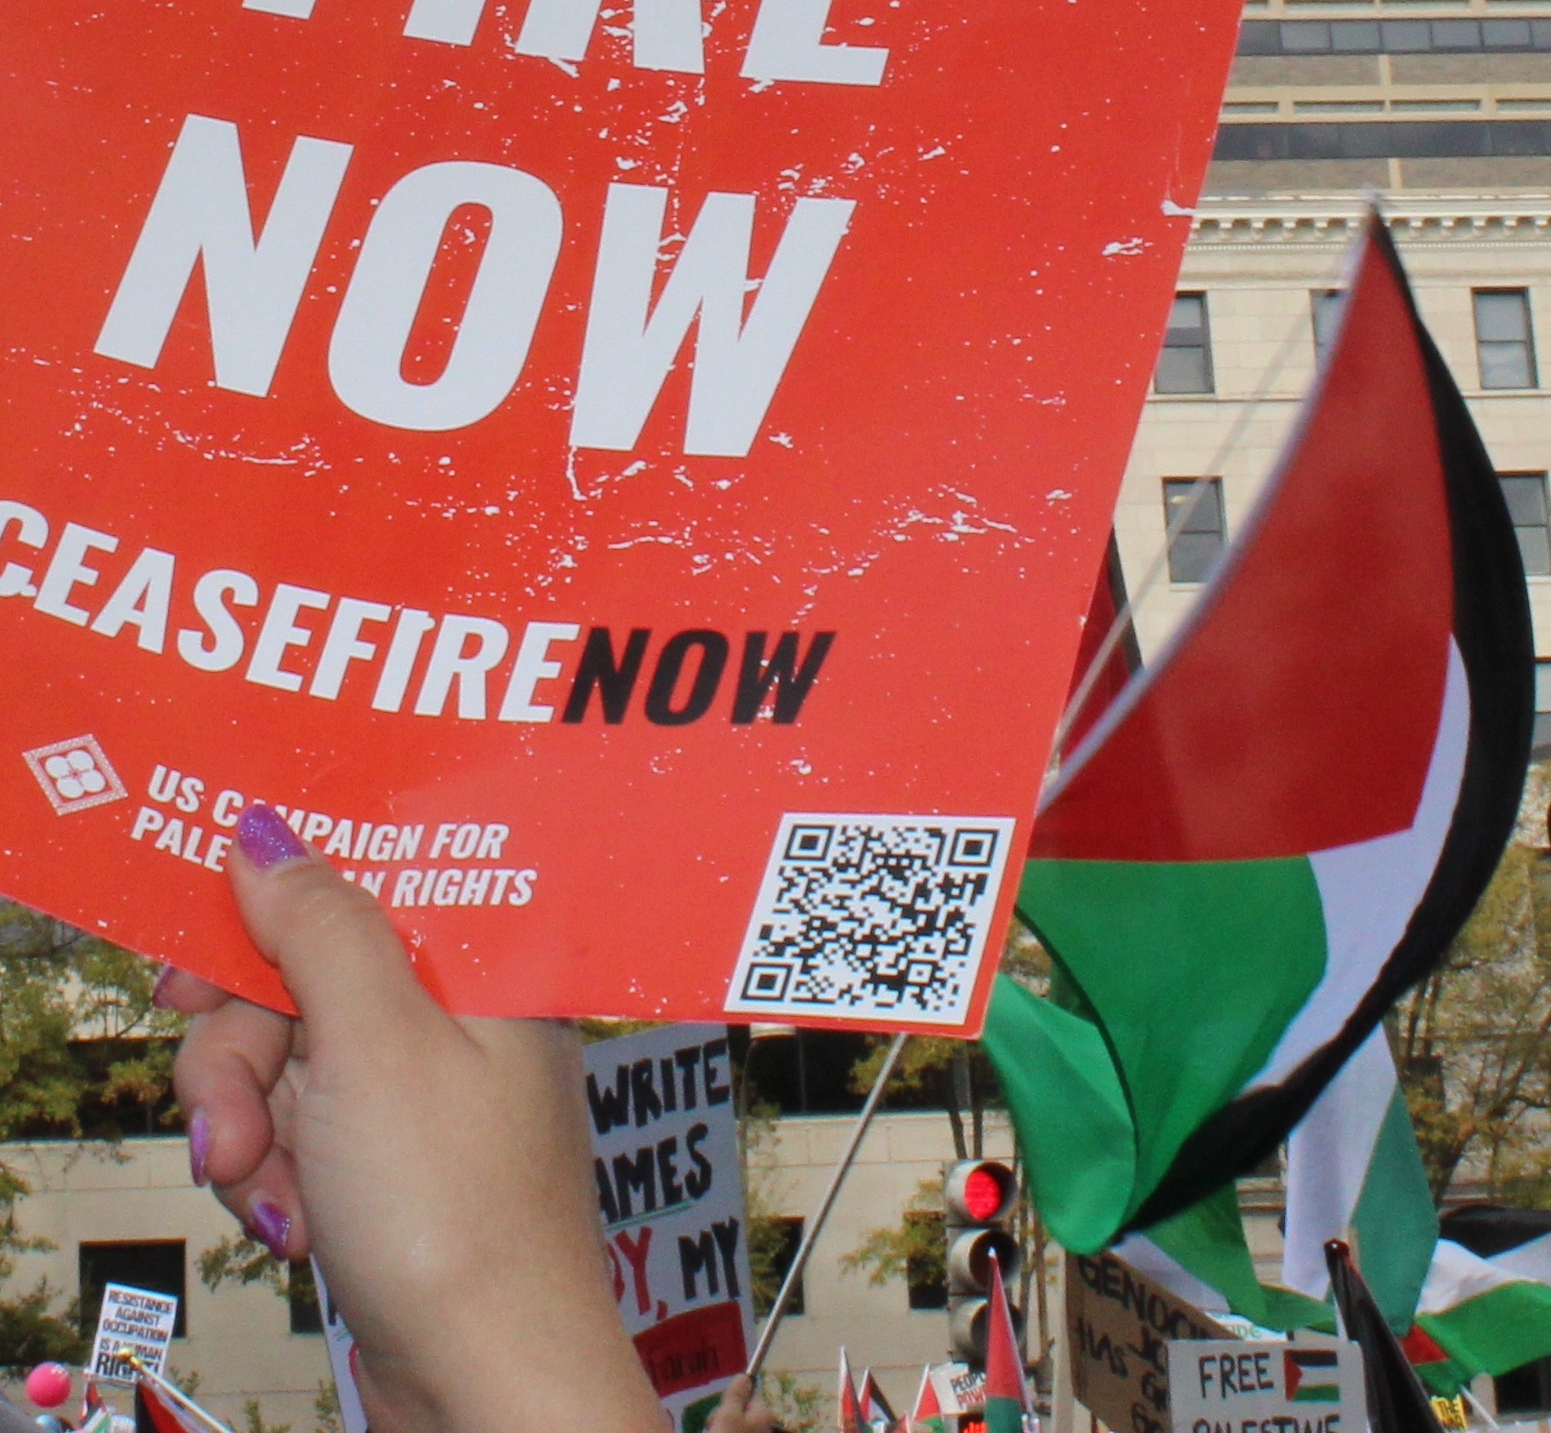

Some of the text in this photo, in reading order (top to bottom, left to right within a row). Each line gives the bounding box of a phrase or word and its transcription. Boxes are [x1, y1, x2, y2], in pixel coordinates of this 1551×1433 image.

[93, 113, 856, 457] NOW
[146, 764, 206, 814] US
[211, 788, 425, 862] CMPAIGN
[429, 822, 510, 860] FOR
[390, 868, 539, 908] RIGHTS
[586, 1037, 731, 1135] WRITE
[677, 1215, 741, 1301] MY
[102, 1318, 169, 1343] OCCUPATION
[108, 1289, 173, 1314] RESISTANCE
[115, 1306, 161, 1327] AGAINST
[1077, 1254, 1211, 1340] GENOC
[1199, 1351, 1274, 1399] FREE
